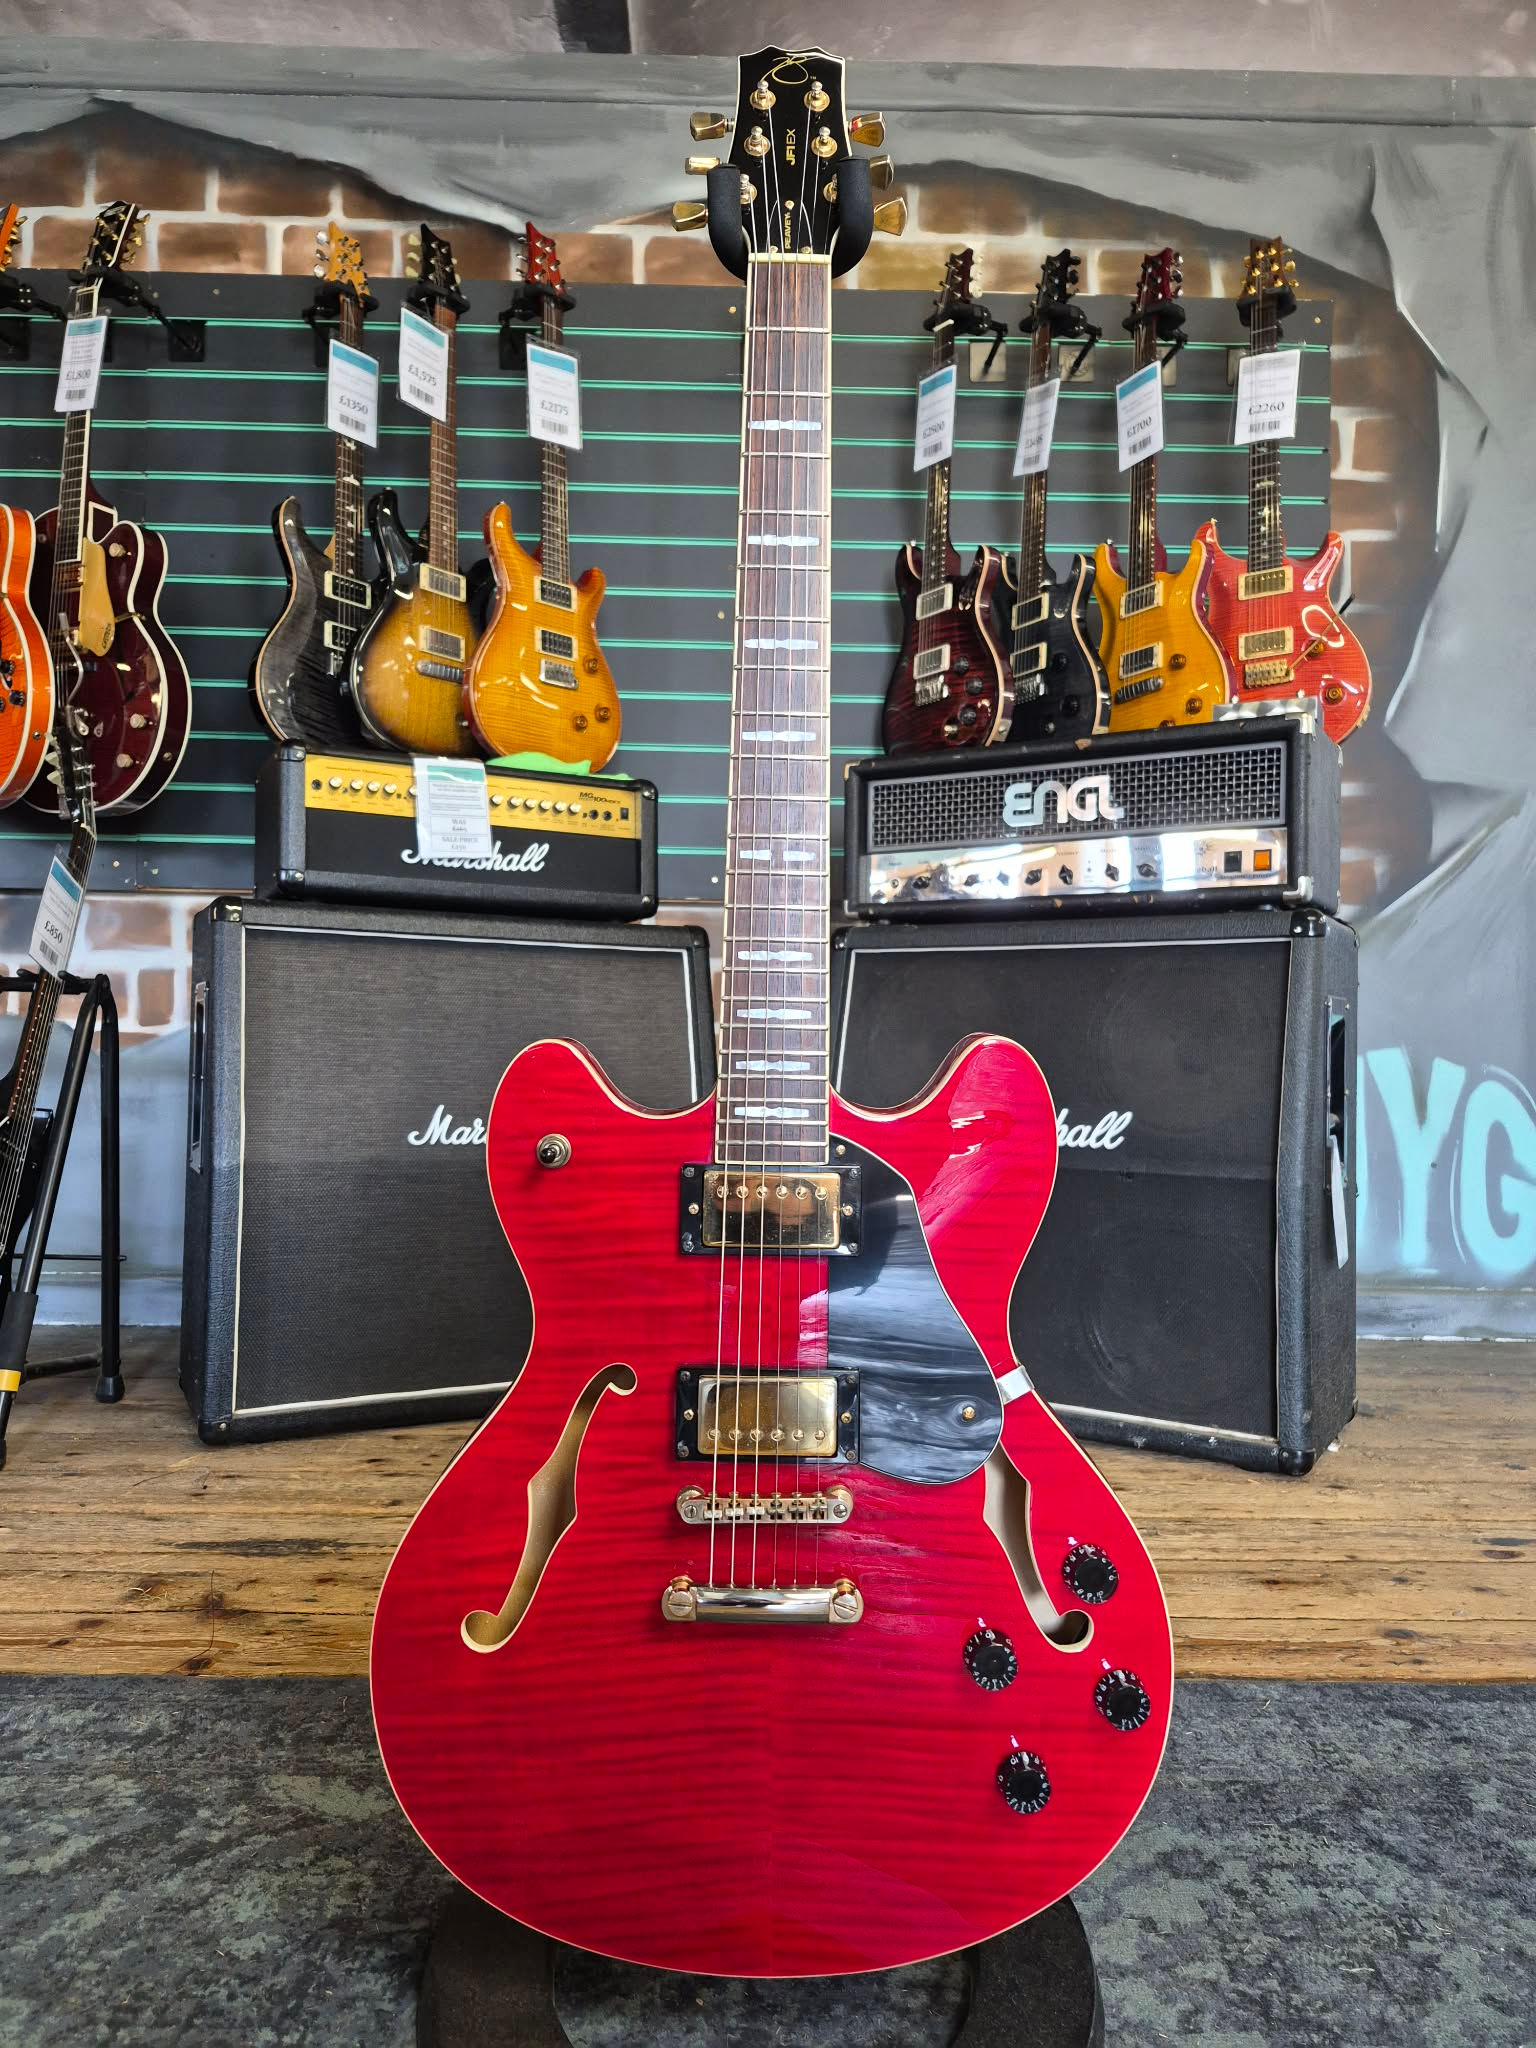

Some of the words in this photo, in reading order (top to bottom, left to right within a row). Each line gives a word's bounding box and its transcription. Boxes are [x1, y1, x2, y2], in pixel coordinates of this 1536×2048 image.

[784, 213, 792, 249] PEAVEY
[407, 364, 437, 388] £1,575
[338, 394, 369, 416] £1350
[540, 398, 569, 417] £2175
[1248, 401, 1285, 416] £2260
[1002, 774, 1125, 828] ENGL
[44, 920, 63, 944] £850
[407, 1104, 487, 1146] Mar
[1056, 1108, 1134, 1150] hall
